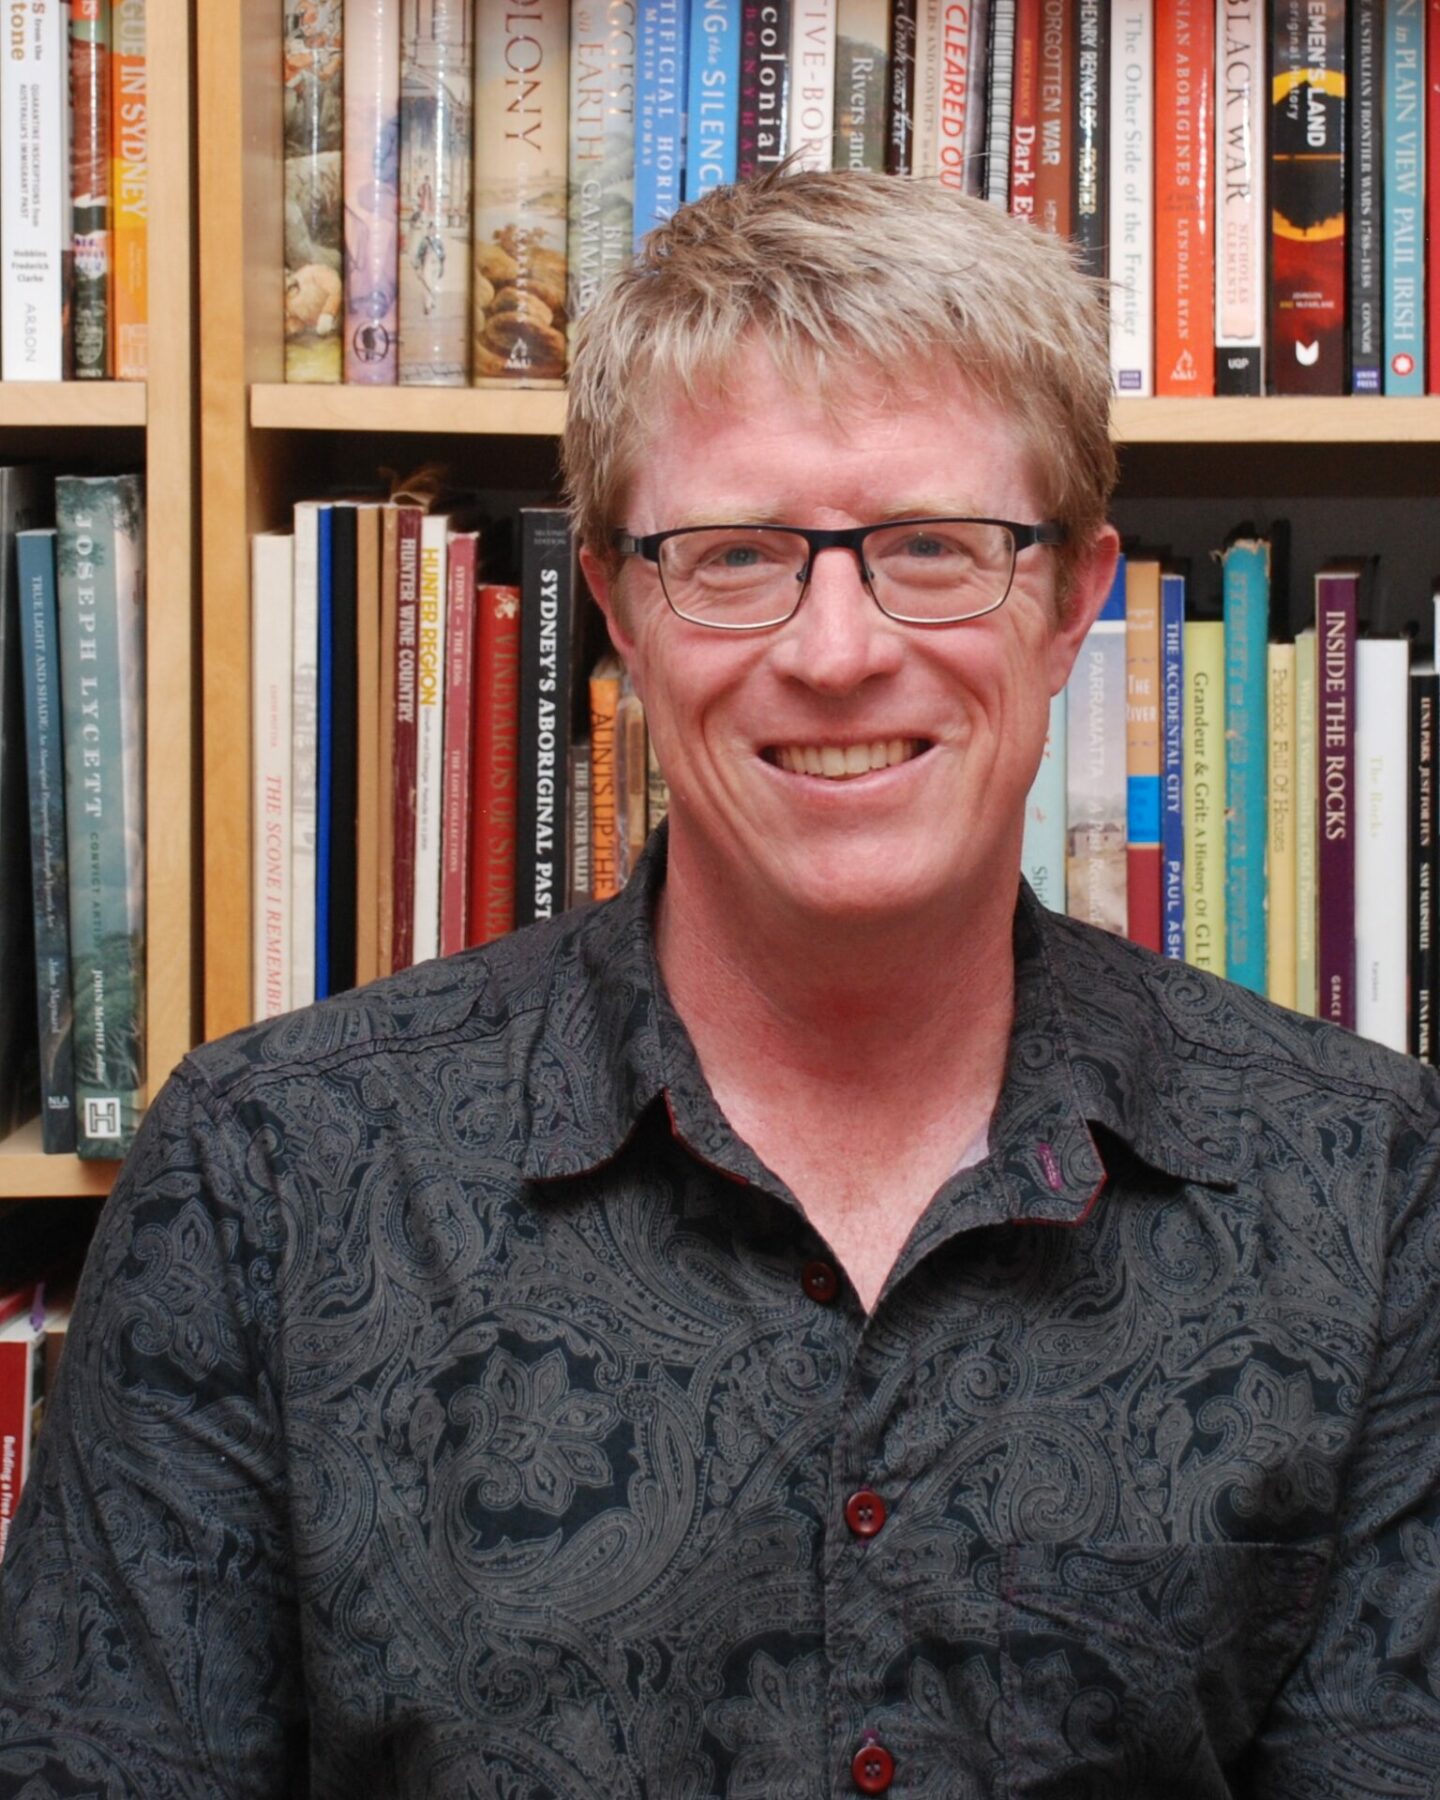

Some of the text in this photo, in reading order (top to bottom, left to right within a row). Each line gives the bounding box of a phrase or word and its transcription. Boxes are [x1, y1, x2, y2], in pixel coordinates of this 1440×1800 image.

[10, 2, 32, 61] tone
[34, 18, 44, 61] from the
[706, 35, 722, 65] the
[925, 35, 938, 62] AND
[1080, 0, 1097, 46] HENRY
[120, 65, 146, 96] IN
[577, 9, 604, 162] on EARTH
[757, 6, 786, 163] colonial
[923, 67, 937, 132] CONVICTS
[941, 4, 970, 137] CLEARED
[1041, 0, 1063, 166] ORGOTTEN WAR
[1079, 51, 1098, 129] REYNOLDS
[1286, 64, 1302, 121] History
[849, 57, 874, 173] Rivers and
[1175, 52, 1192, 188] ABORIGINES
[1306, 86, 1327, 147] LAND
[20, 141, 30, 196] IMMIGRANT
[31, 83, 42, 228] QUARANTINE INSCRIPTIONS from
[120, 102, 146, 220] SYDNEY
[1014, 125, 1036, 187] Dark
[1078, 147, 1097, 216] FRONTIER
[1124, 13, 1144, 337] The Other Side of the Frontier
[1226, 121, 1252, 205] WAR
[1359, 10, 1373, 354] AUSTRALIAN FRONTIER WARS CONNOR
[1392, 25, 1417, 341] in PLAIN VIEW PAUL IRISH
[20, 196, 30, 219] PAST
[16, 274, 45, 283] Clarke
[1177, 218, 1190, 340] LYNDALL RYAN
[1226, 222, 1238, 306] CLEMENTS
[1238, 222, 1249, 304] NICHOLAS
[23, 302, 38, 363] ARBON
[1227, 357, 1249, 370] UQP
[32, 575, 43, 610] TRUE
[397, 537, 417, 723] HUNTER WINE COUNTRY
[418, 547, 439, 706] HUNTER REGION
[453, 565, 466, 655] SYDNEY THE
[34, 612, 46, 652] LIGHT
[35, 654, 47, 683] AND
[73, 514, 103, 818] JOSEPH LYCETT
[1166, 620, 1180, 655] THE
[489, 630, 519, 831] VINEYARDS OF
[534, 568, 558, 920] SYDNEY'S ABORIGINAL PAST
[1088, 651, 1106, 779] PARRAMATTA
[1166, 660, 1180, 768] ACCIDENTAL
[1193, 671, 1210, 757] Grandeur
[264, 774, 284, 815] THE
[1166, 773, 1180, 814] CITY
[1193, 762, 1209, 776] &
[1271, 668, 1290, 853] Paddock Full Of Houses
[1369, 755, 1383, 785] The
[448, 749, 462, 874] THE LOST COLLECTIONS
[574, 760, 589, 892] THE HUNTER VALLEY
[591, 711, 616, 893] AUNTS UP THE
[1193, 781, 1211, 824] Grit:
[1194, 827, 1207, 839] A
[1325, 609, 1346, 1016] INSIDE THE ROCKS GRACE
[1369, 792, 1383, 839] Rocks
[89, 831, 102, 894] CONVICT
[264, 821, 284, 895] SCONE
[1167, 860, 1180, 912] PAUL
[1191, 842, 1209, 895] History
[1418, 697, 1432, 1054] LUNA PARK JUST FOR FUN SAM MARSHALL LUNA PARK
[1194, 898, 1209, 919] Of
[47, 957, 62, 1034] John Maynard
[92, 969, 106, 1001] JOHN
[1, 1435, 17, 1516] Building free
